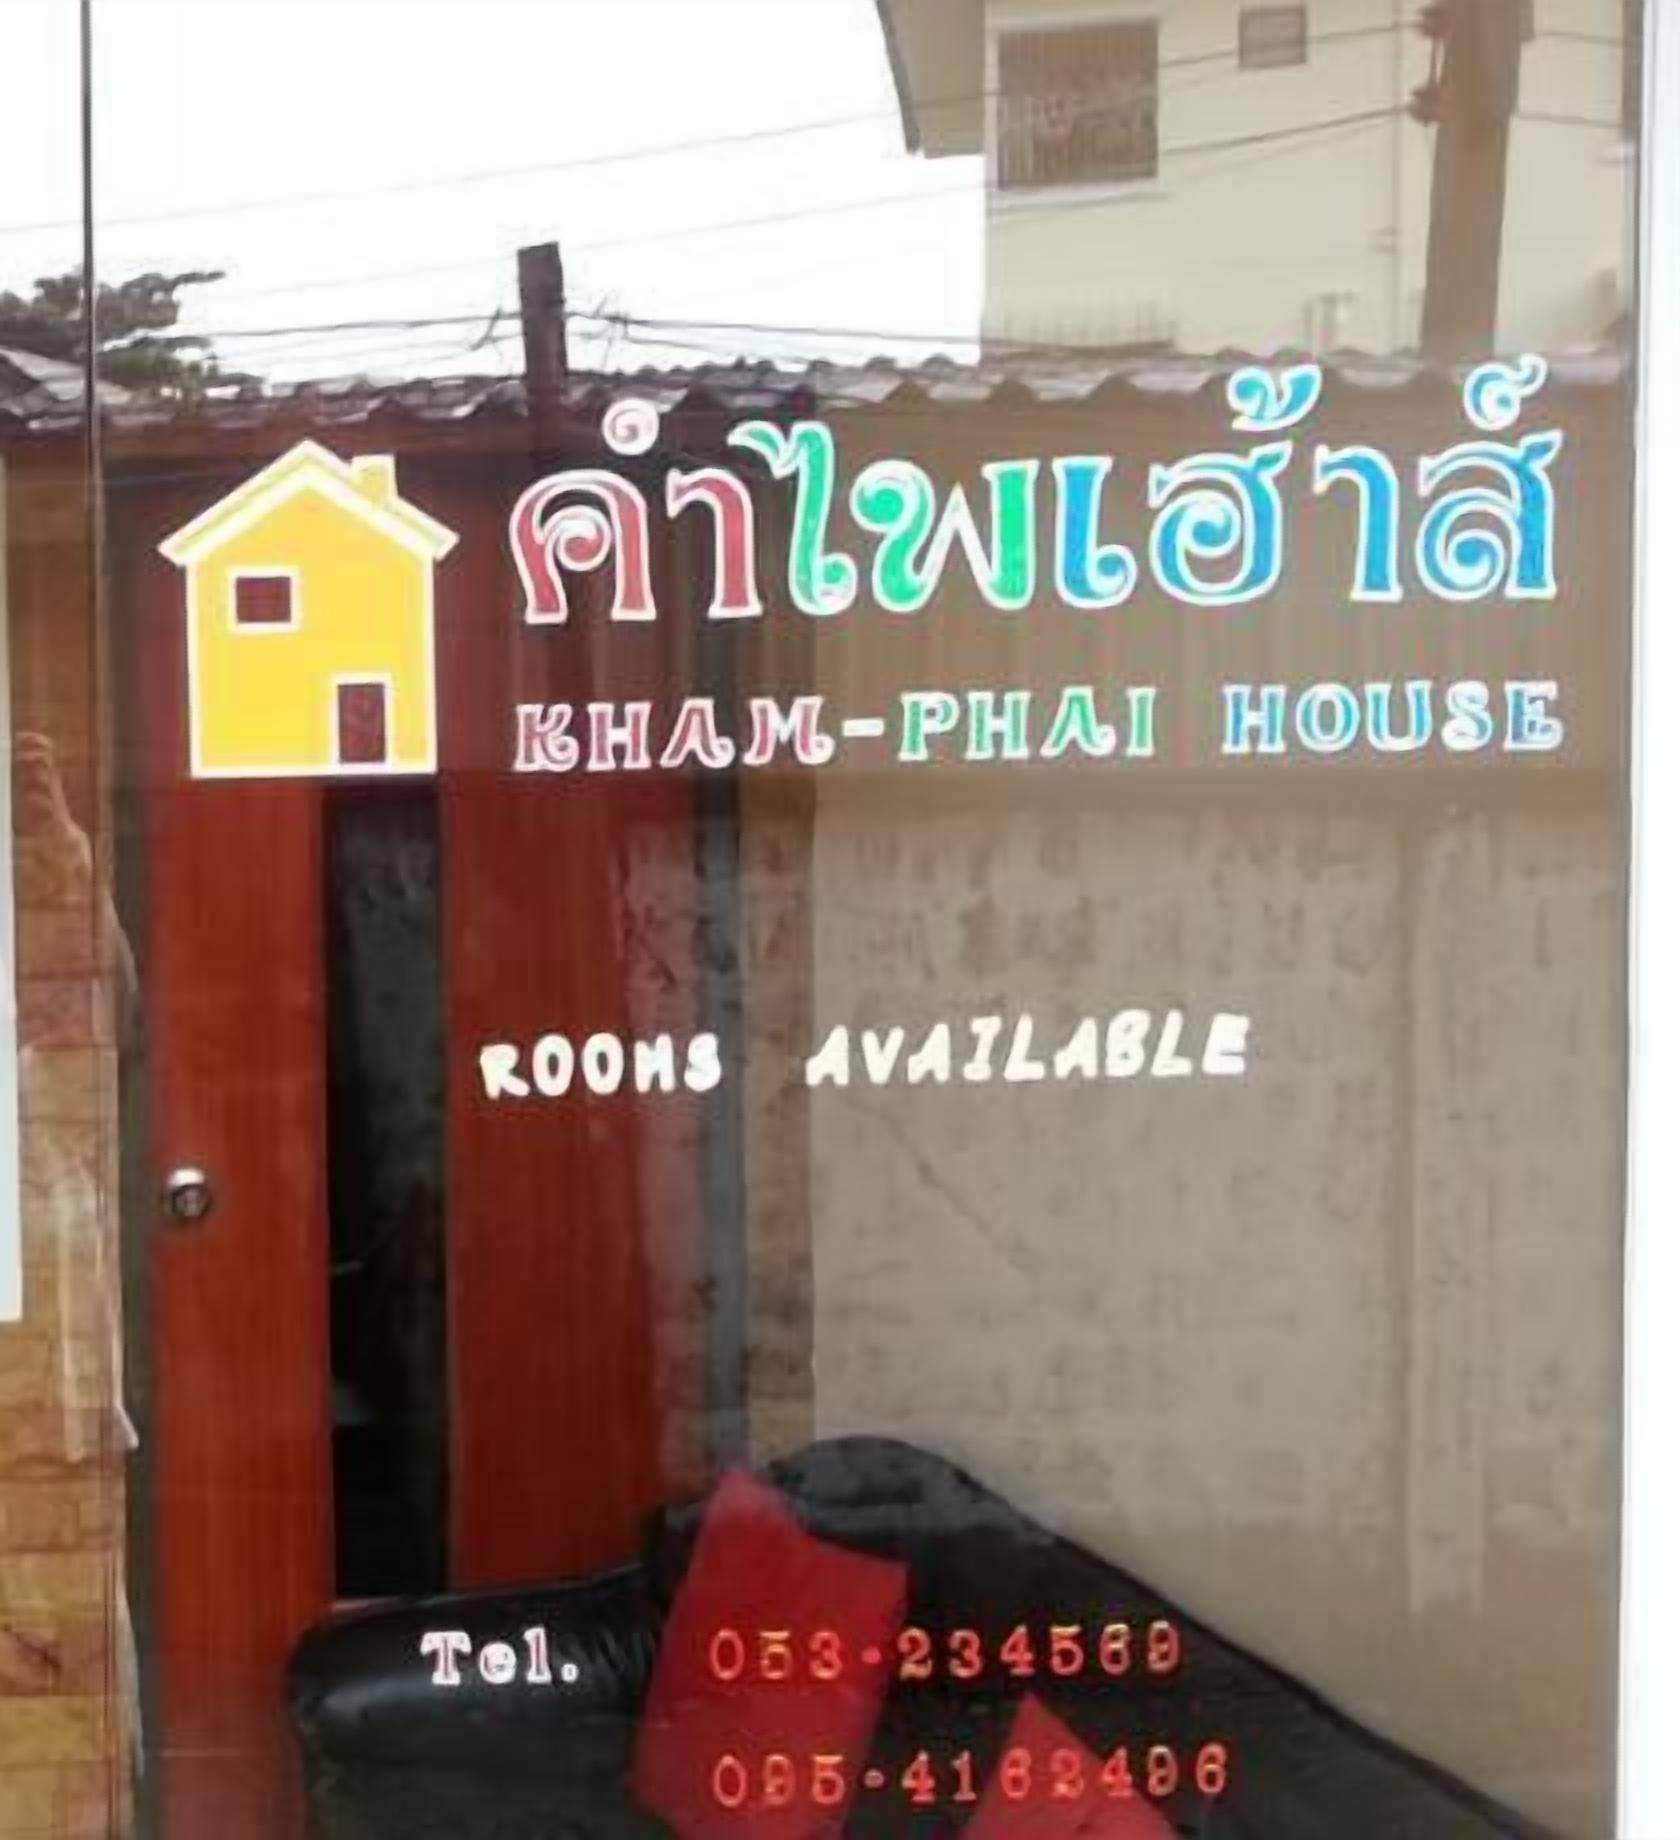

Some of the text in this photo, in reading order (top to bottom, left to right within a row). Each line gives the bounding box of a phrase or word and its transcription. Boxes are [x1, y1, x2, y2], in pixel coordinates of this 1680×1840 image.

[507, 354, 1565, 624] คำไพเฮ้าส์
[513, 680, 1564, 773] KHAM-PHAI HOUSE
[478, 1009, 1252, 1099] ROOMS AVAILABLE
[419, 1625, 580, 1687] Tel.
